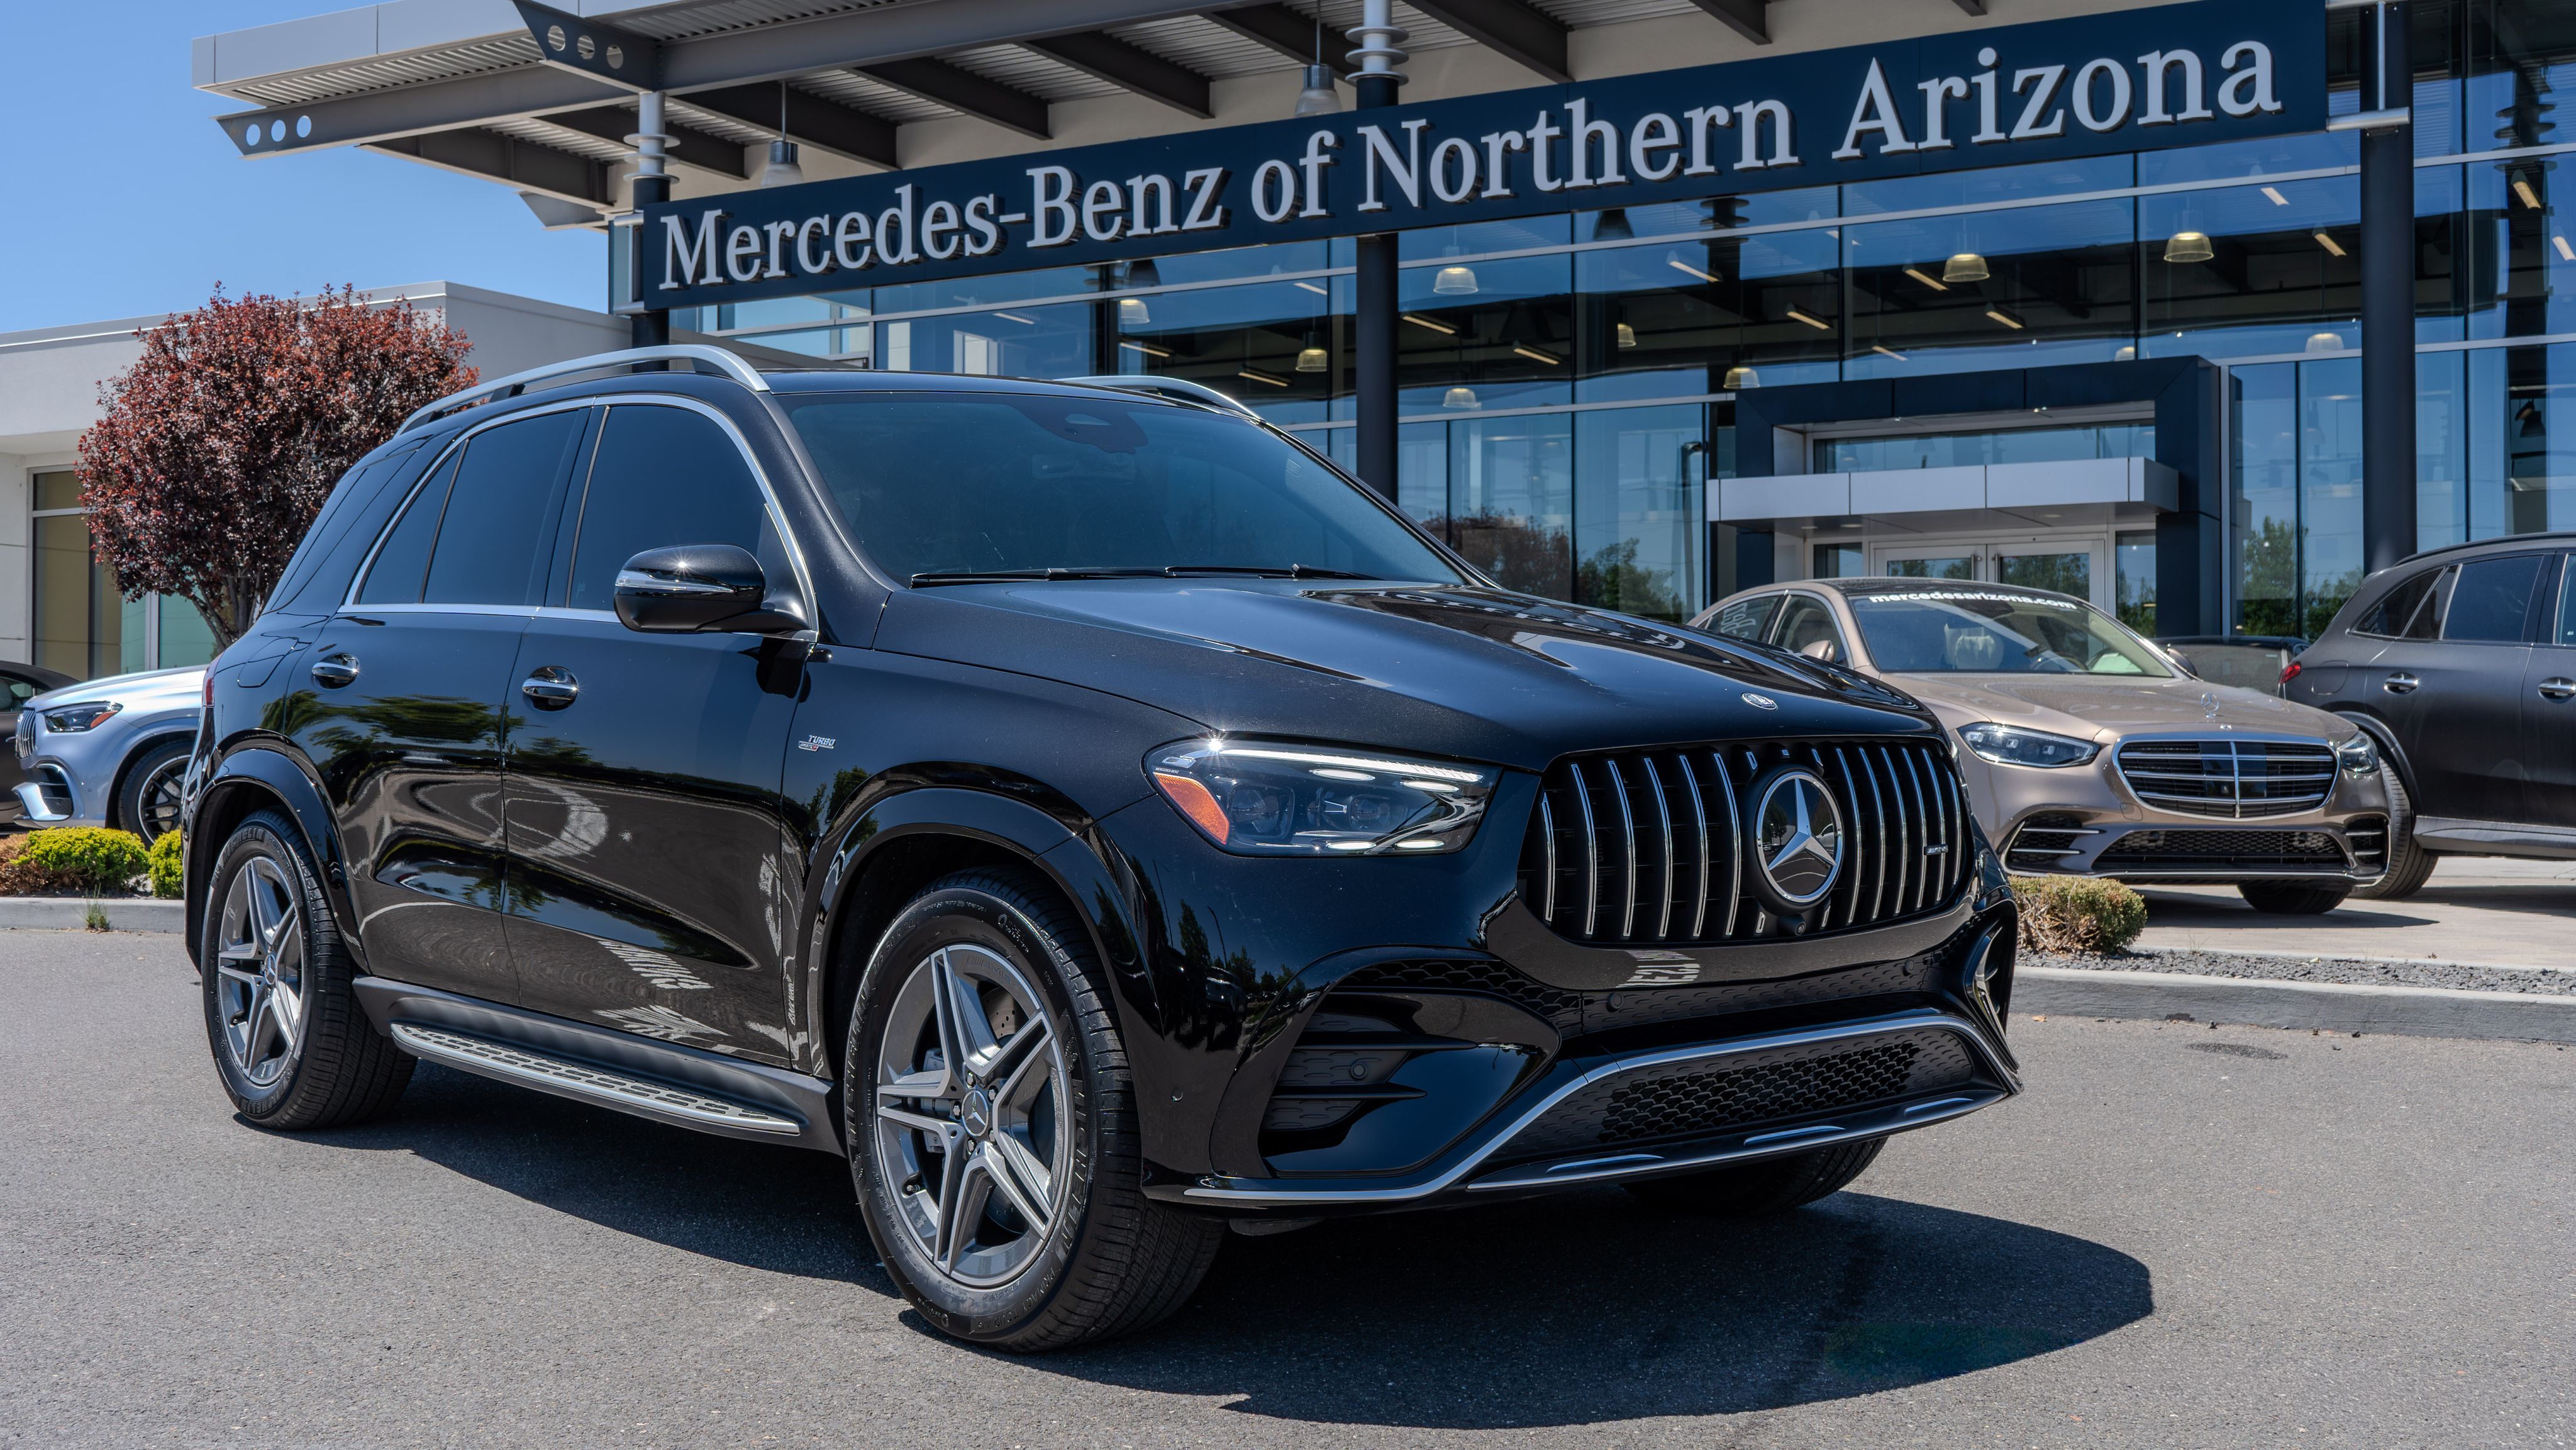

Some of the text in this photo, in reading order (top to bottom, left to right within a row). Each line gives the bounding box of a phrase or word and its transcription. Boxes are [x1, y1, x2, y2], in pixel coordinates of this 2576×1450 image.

[660, 41, 2282, 291] Mercedes-Benz of Northern Arizona
[1868, 591, 2077, 610] mercedesarizona.com
[809, 735, 836, 746] TURBO
[1021, 1267, 1056, 1313] PRIMACY
